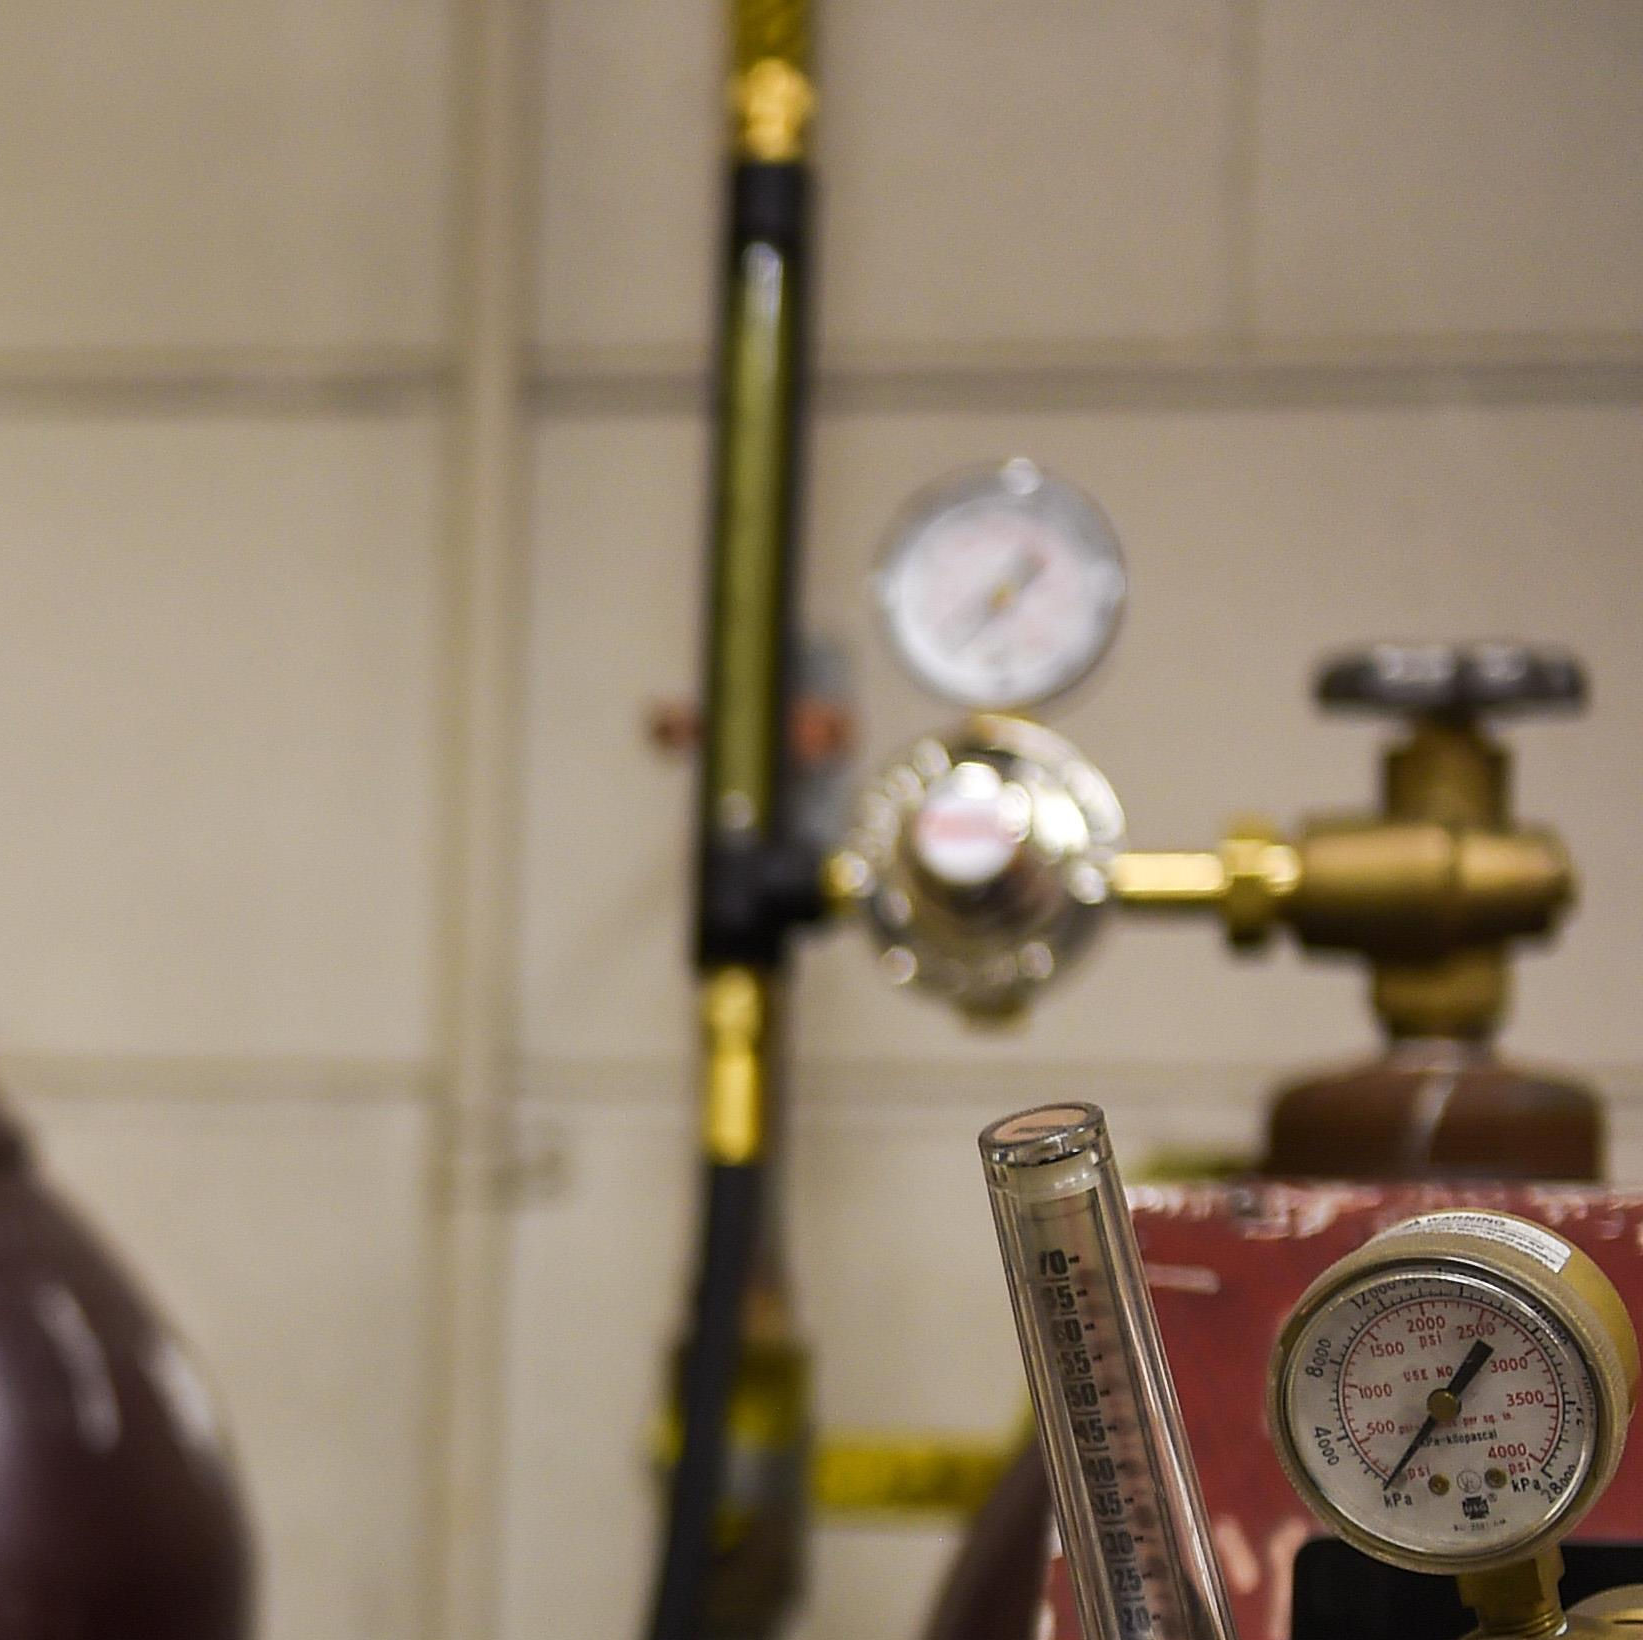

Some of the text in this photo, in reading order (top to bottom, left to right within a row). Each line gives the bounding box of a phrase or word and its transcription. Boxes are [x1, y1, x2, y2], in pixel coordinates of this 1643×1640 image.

[1407, 1316, 1446, 1333] 2000
[1457, 1323, 1496, 1339] 2500
[1419, 1331, 1442, 1349] psi
[1370, 1342, 1405, 1357] 1500
[1305, 1338, 1331, 1378] 8000
[1490, 1357, 1528, 1373] 3000
[1403, 1369, 1429, 1382] USE
[1359, 1384, 1393, 1399] 1000
[1506, 1390, 1544, 1407] 3500
[1367, 1420, 1395, 1435] 500
[1315, 1426, 1340, 1466] 4000
[1488, 1443, 1527, 1459] 4000
[1407, 1466, 1431, 1480] psi
[1508, 1459, 1531, 1475] psi
[1512, 1479, 1541, 1492] kPa
[1383, 1493, 1413, 1508] kPa
